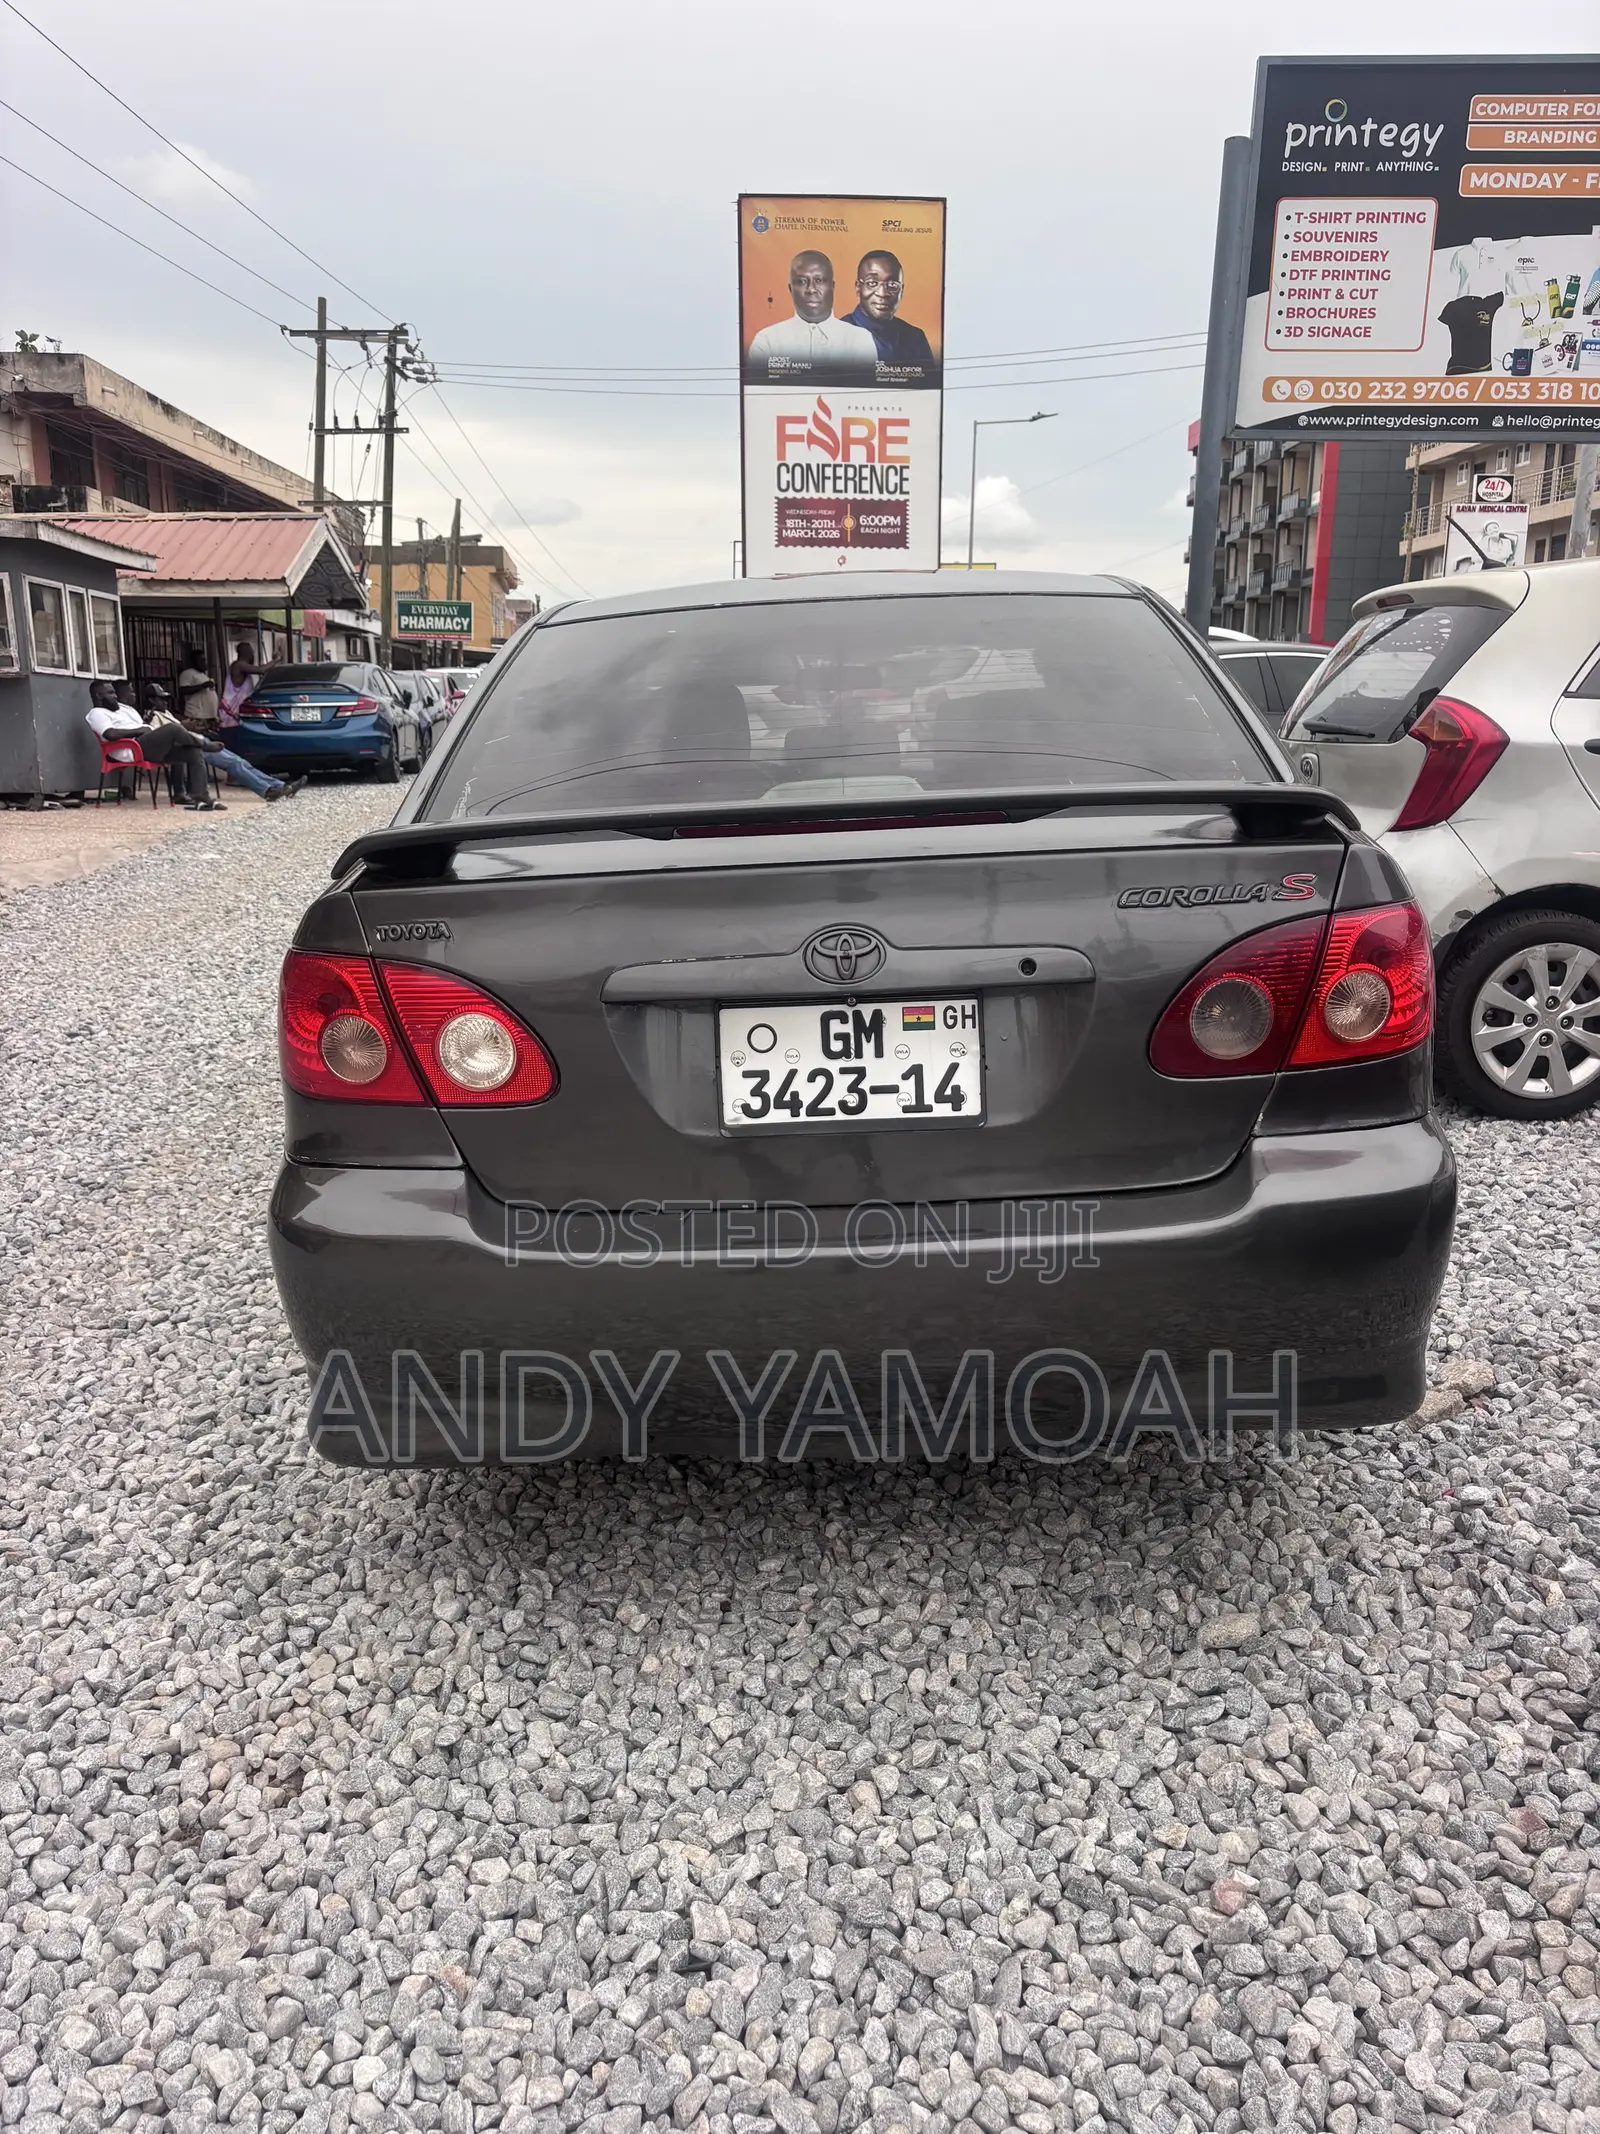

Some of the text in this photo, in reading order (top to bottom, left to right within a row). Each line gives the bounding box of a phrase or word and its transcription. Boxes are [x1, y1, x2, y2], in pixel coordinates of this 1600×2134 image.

[1475, 101, 1600, 117] COMPUTER FO
[1284, 98, 1445, 159] printegy
[1503, 130, 1597, 145] BRANDING
[1469, 172, 1567, 189] MONDAY
[881, 219, 902, 227] SPCI
[1294, 211, 1427, 224] T-SHIRT PRINTING
[800, 223, 849, 232] INTERNATIONAL
[1292, 231, 1378, 243] SOUVENIRS
[1290, 250, 1390, 262] EMBROIDERY
[1517, 256, 1535, 265] epic
[1288, 269, 1392, 281] DTF PRINTING
[1287, 288, 1379, 300] PRINT & CUT
[1285, 307, 1377, 319] BROCHURES
[1284, 326, 1372, 338] 3D SIGNAGE
[1320, 381, 1362, 399] 030
[1368, 381, 1409, 399] 232
[1413, 381, 1470, 399] 9706
[1473, 379, 1487, 401] /
[1490, 382, 1531, 400] 053
[1535, 382, 1573, 400] 318
[1309, 414, 1479, 428] www.printegydesign.com
[776, 463, 910, 495] CONFERENCE
[1485, 479, 1505, 491] 24/7
[1456, 505, 1527, 513] RAYAN MEDICAL CENTRE
[786, 519, 806, 528] 18TH
[812, 519, 836, 528] 20TH
[860, 515, 901, 526] 6:00PM
[818, 530, 841, 538] 2026
[411, 605, 459, 615] EVERYDAY
[400, 615, 470, 630] PHARMACY
[1117, 873, 1317, 908] COROLLA S
[376, 921, 452, 941] TOYOTA
[942, 1004, 977, 1030] GH
[820, 1009, 884, 1060] GM
[741, 1062, 966, 1119] 3423-14
